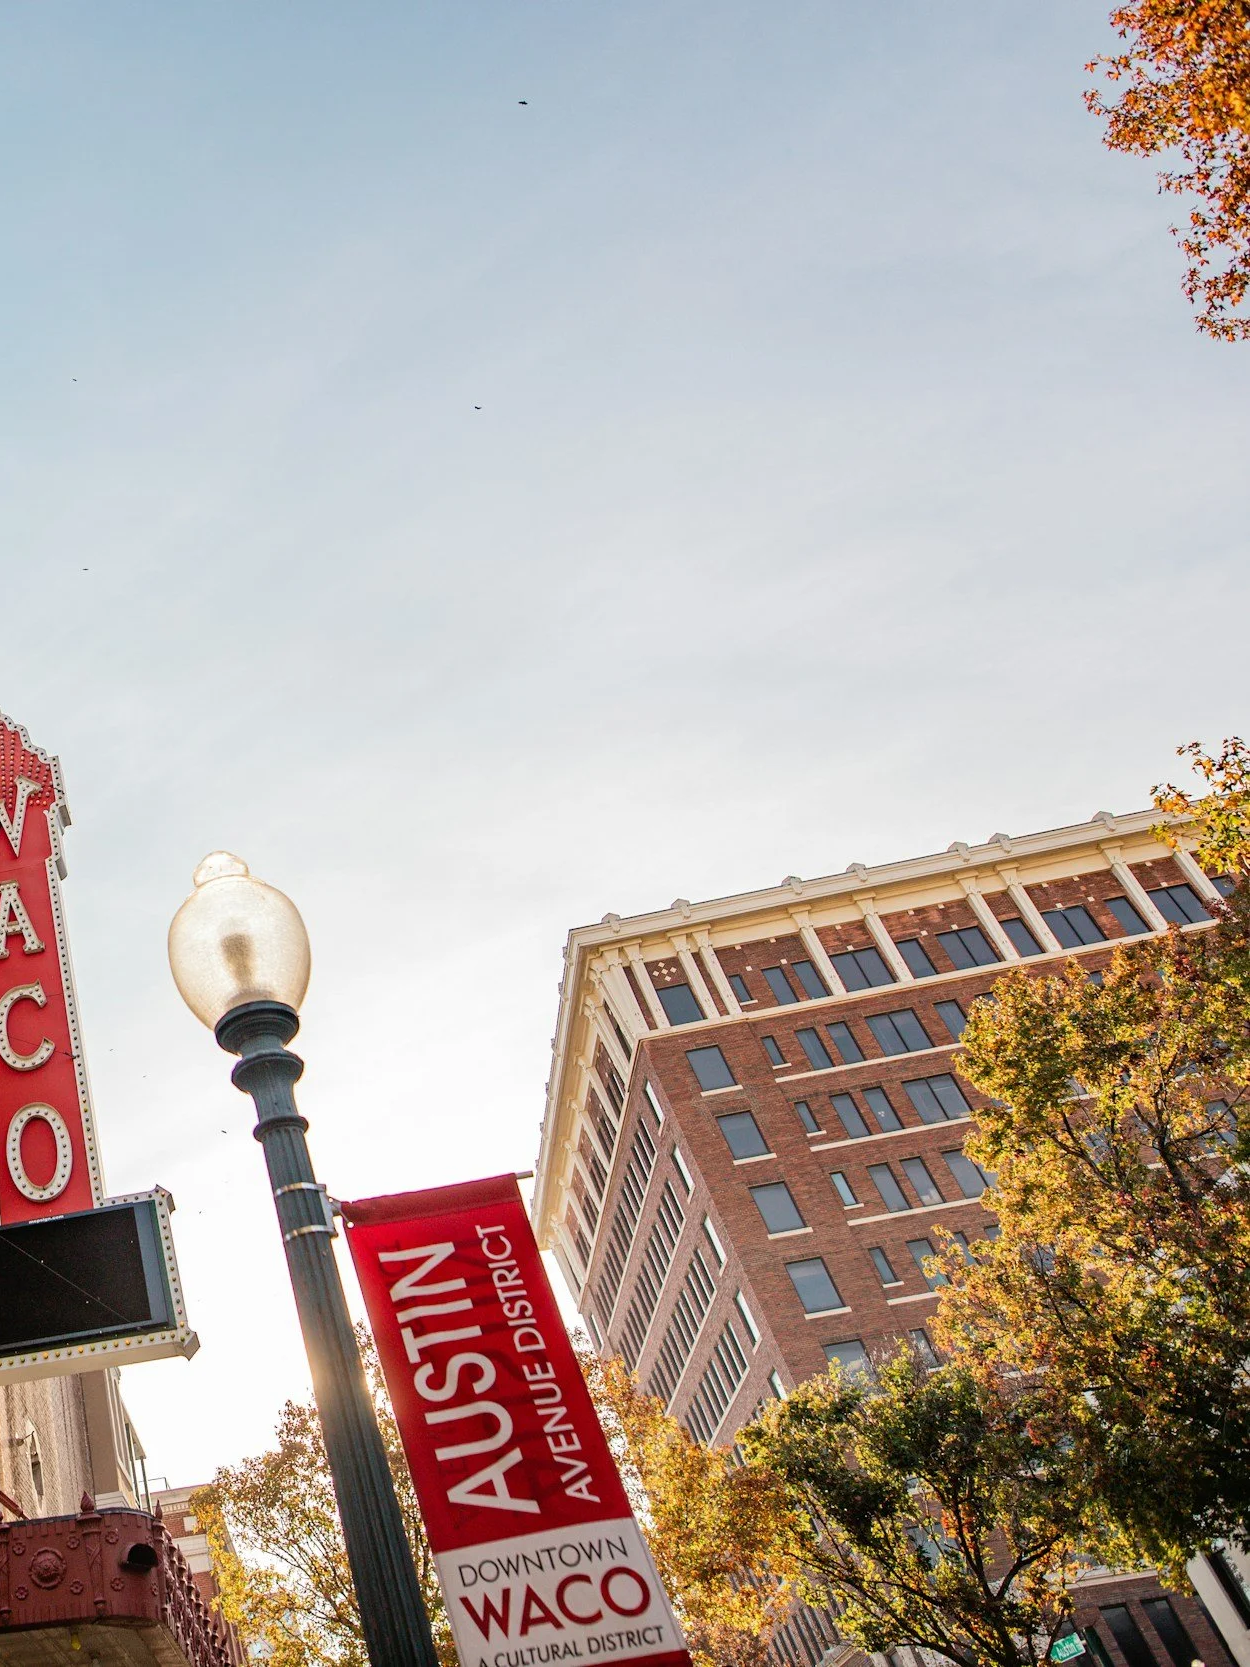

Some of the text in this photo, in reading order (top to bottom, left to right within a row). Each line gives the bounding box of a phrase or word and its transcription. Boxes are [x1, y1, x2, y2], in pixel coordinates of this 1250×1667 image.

[377, 1241, 541, 1514] AUSTIN
[475, 1224, 601, 1503] AVENUE DISTRICT
[458, 1536, 629, 1588] DOWNTOWN
[459, 1566, 651, 1643] WACO
[494, 1640, 584, 1667] CULTURAL
[587, 1625, 664, 1655] DISTRICT
